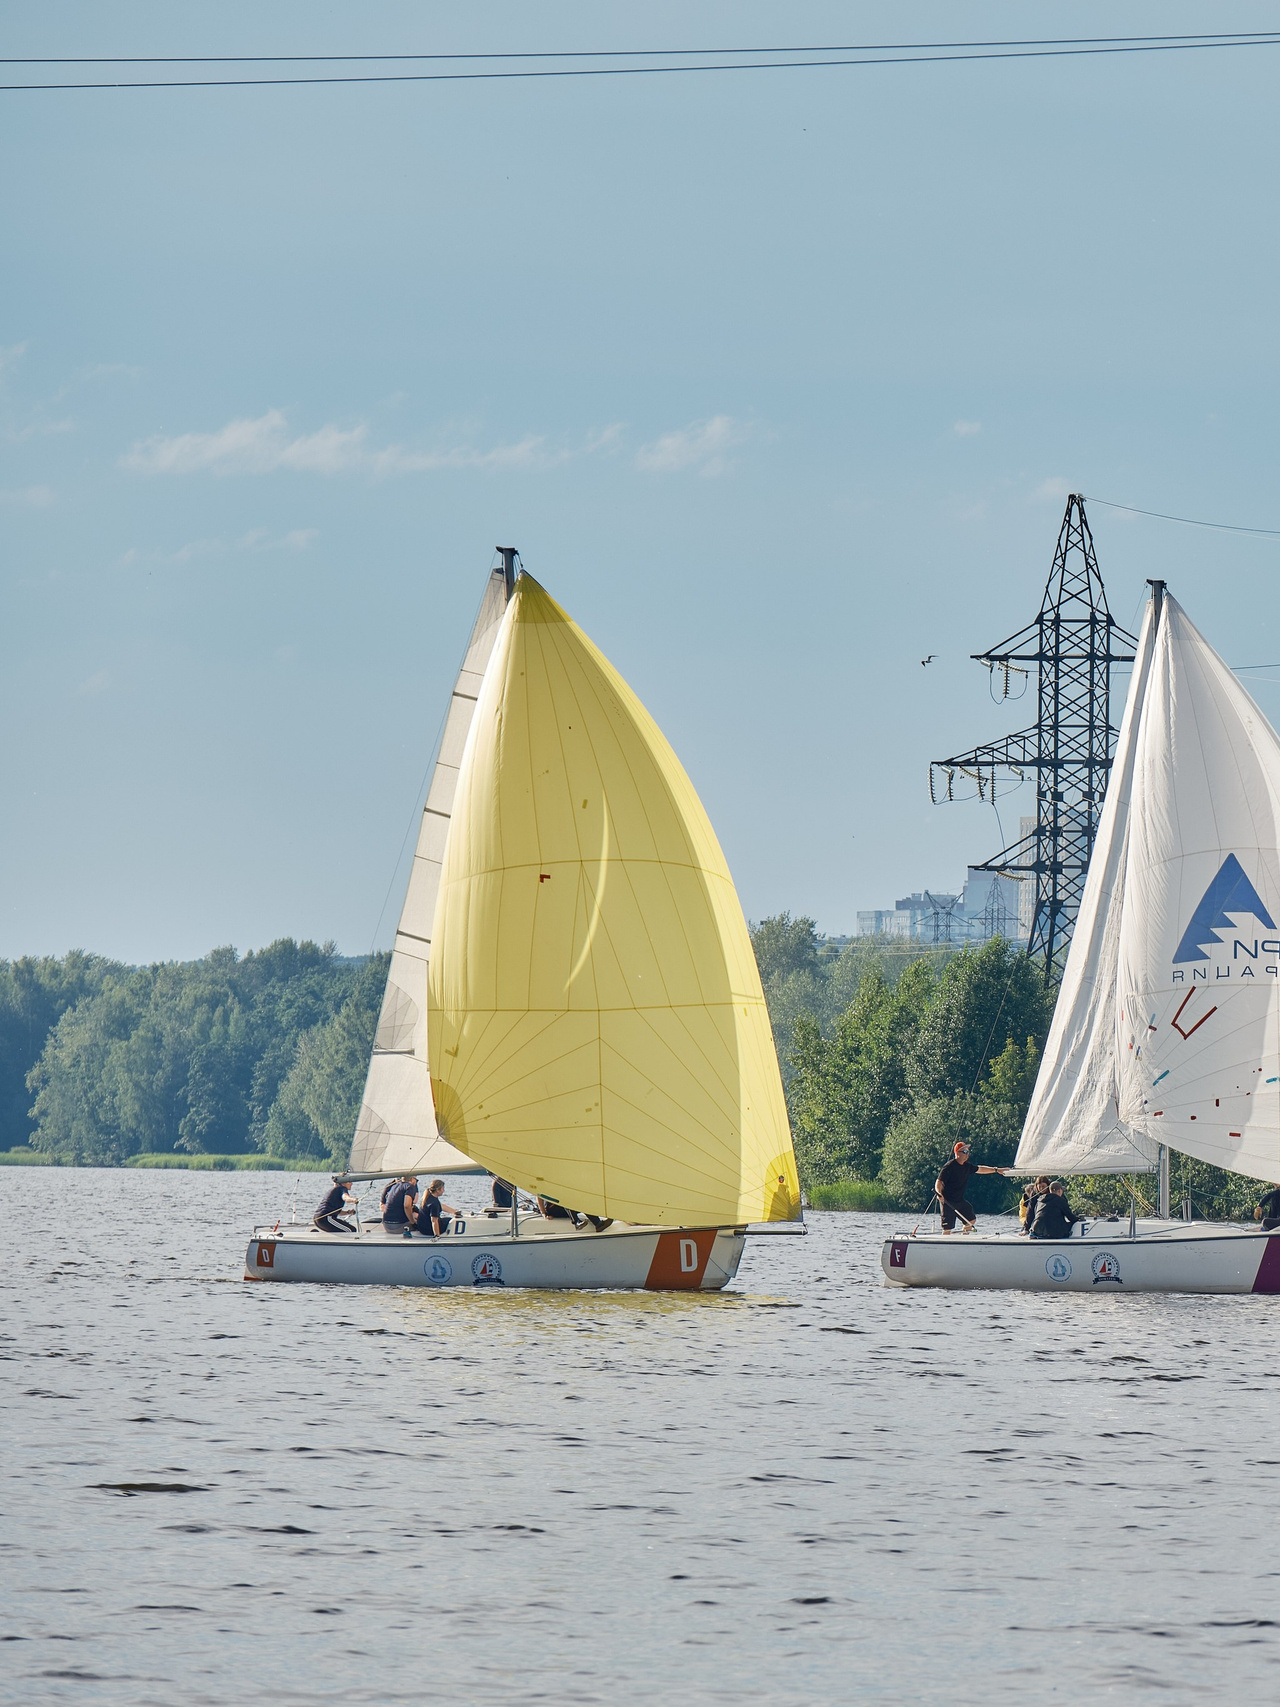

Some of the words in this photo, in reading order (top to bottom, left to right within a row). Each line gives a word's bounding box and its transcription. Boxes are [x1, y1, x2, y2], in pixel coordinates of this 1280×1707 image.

[454, 1220, 466, 1235] D
[1081, 1222, 1091, 1237] F
[261, 1248, 270, 1263] D
[679, 1239, 698, 1273] D
[894, 1248, 901, 1263] F
